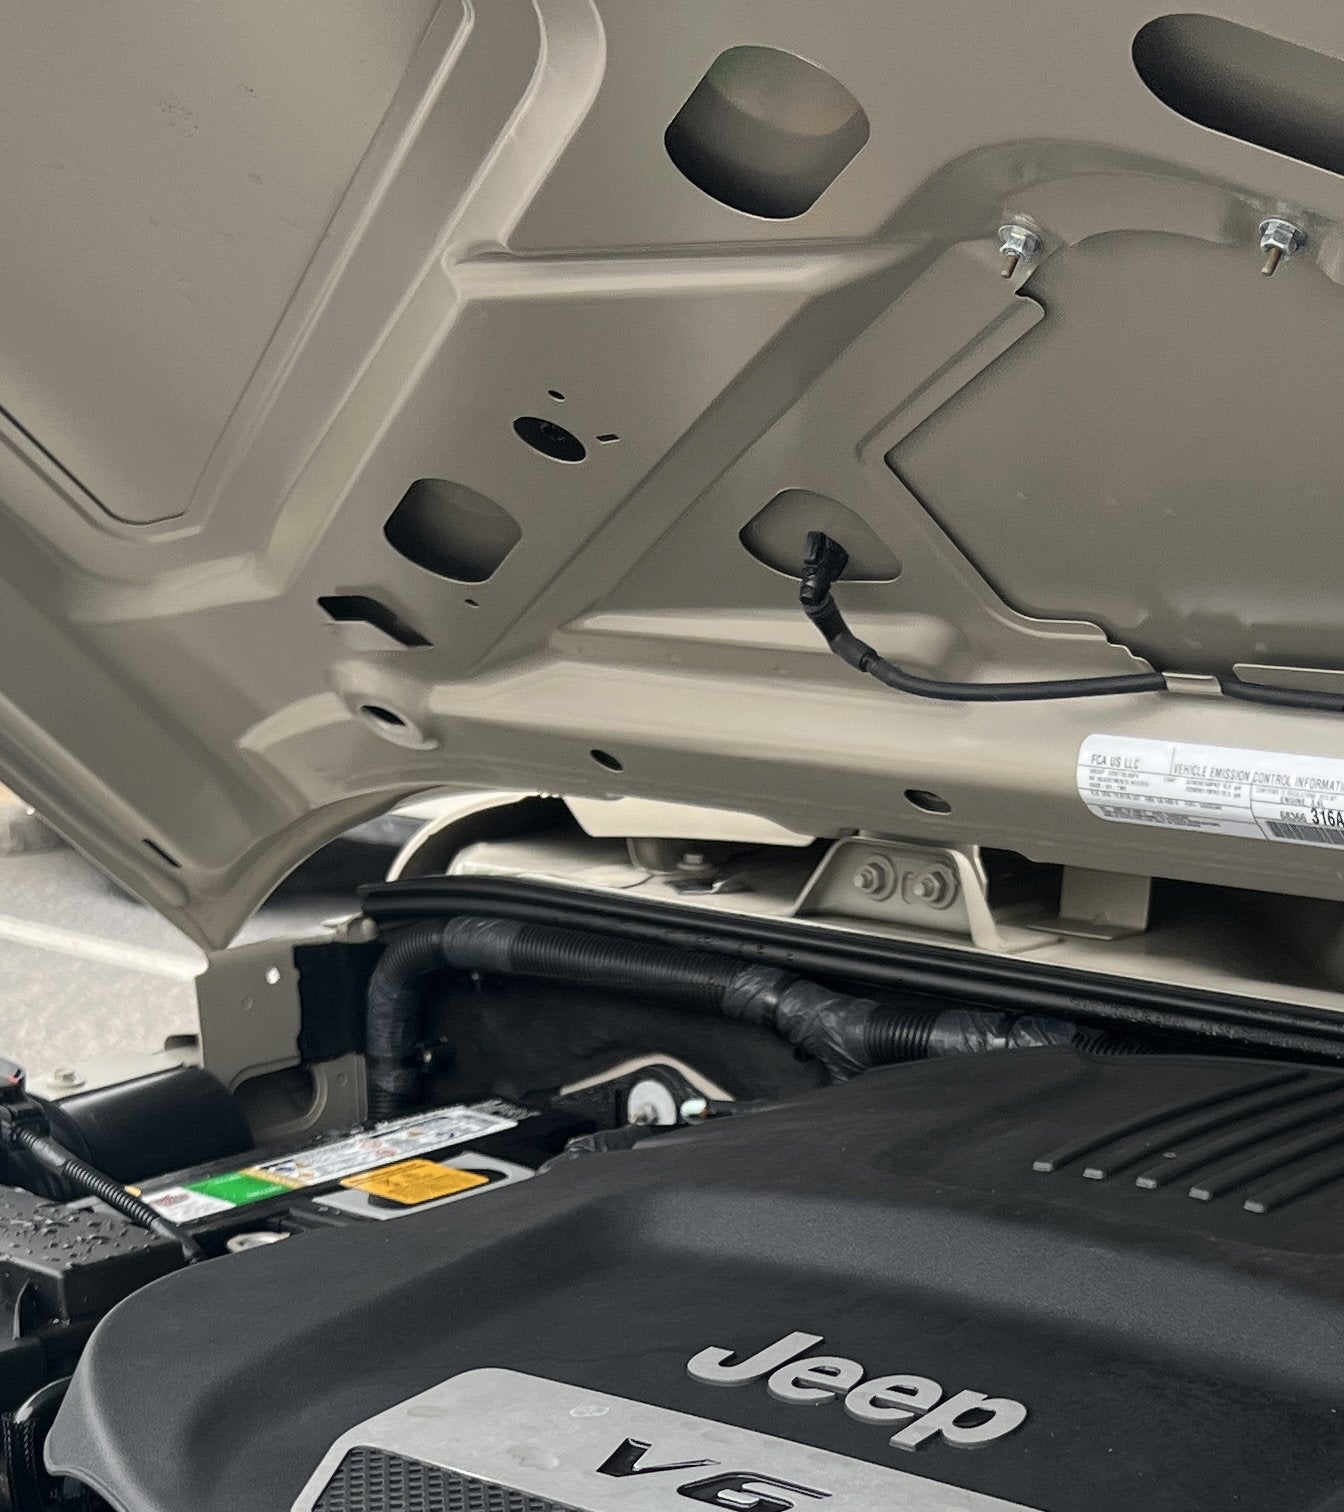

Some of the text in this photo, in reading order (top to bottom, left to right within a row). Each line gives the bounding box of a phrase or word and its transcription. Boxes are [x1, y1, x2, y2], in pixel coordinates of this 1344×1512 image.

[1173, 763, 1207, 778] VEHICLE
[1209, 767, 1251, 782] EMISSION
[1253, 771, 1291, 787] CONTROL
[687, 1331, 1028, 1451] Jeep
